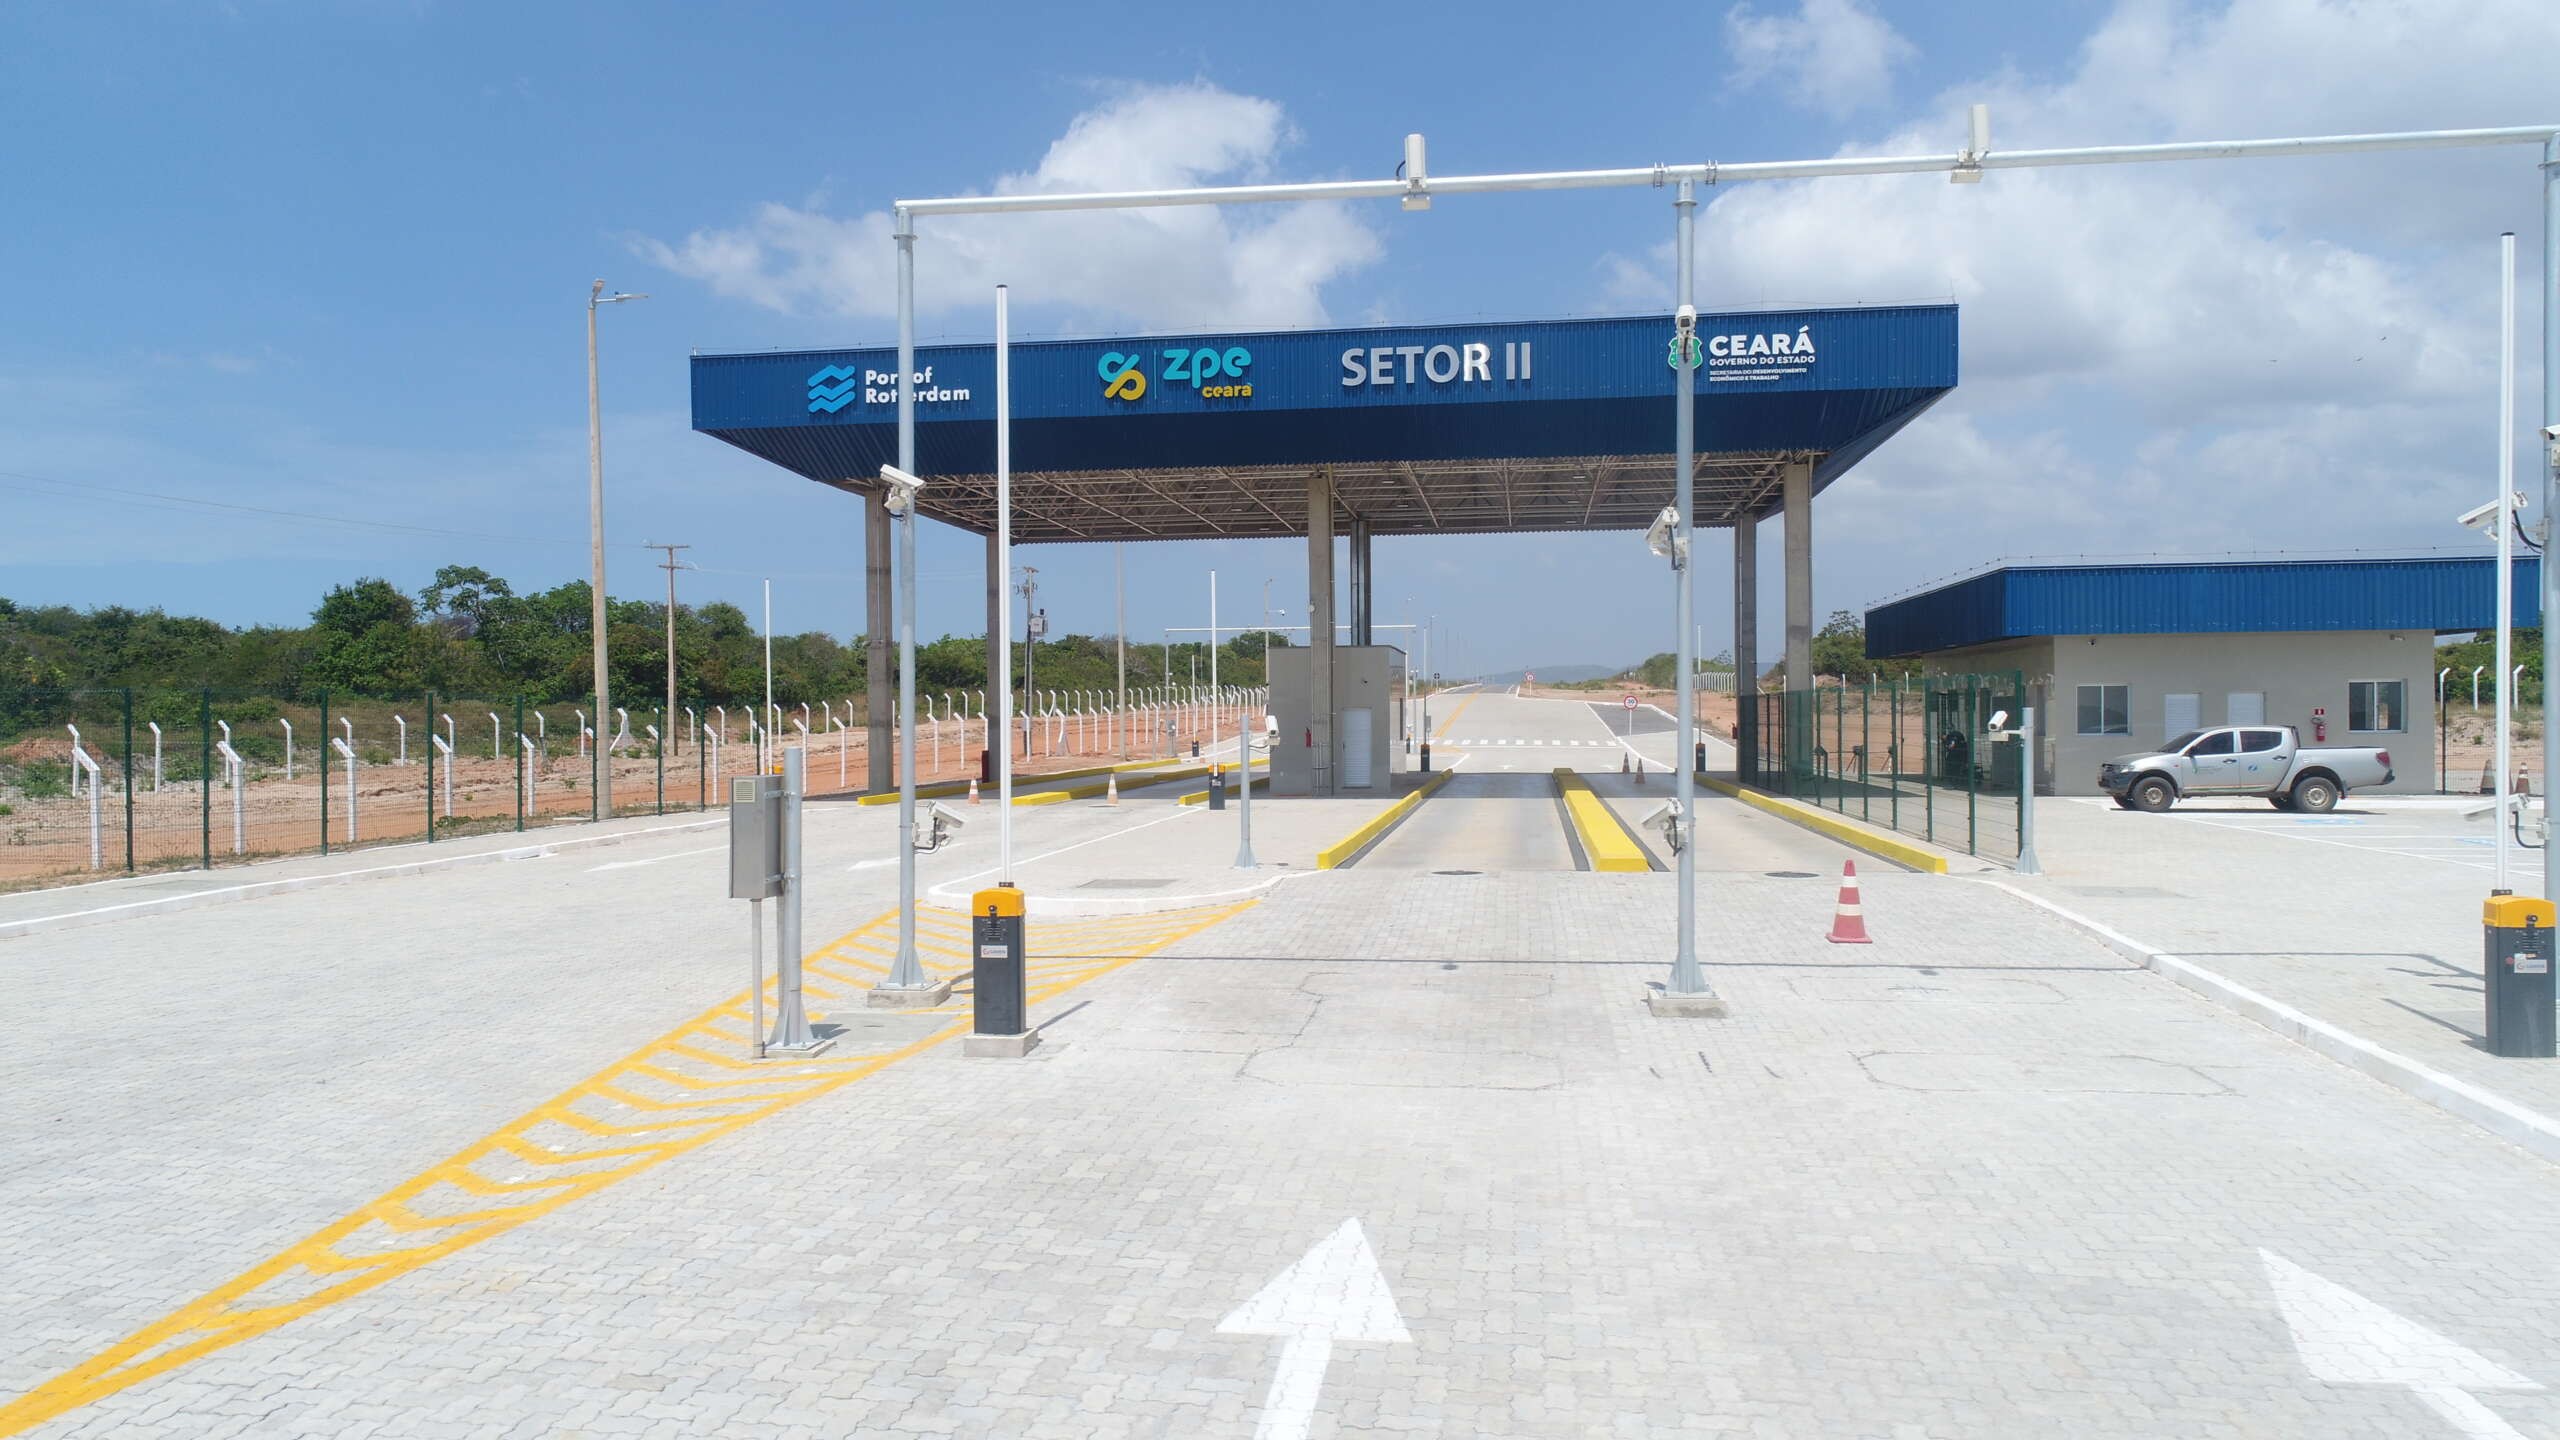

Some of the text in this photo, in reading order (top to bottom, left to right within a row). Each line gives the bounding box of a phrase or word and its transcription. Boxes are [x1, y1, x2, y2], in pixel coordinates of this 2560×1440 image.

[1709, 325, 1816, 356] CEARÁ
[1163, 347, 1251, 388] zpe
[1341, 342, 1531, 387] SETOR II
[1709, 356, 1816, 366] GOVERNO DO ESTADO
[865, 366, 932, 385] Por of
[866, 386, 970, 403] Rotrdam
